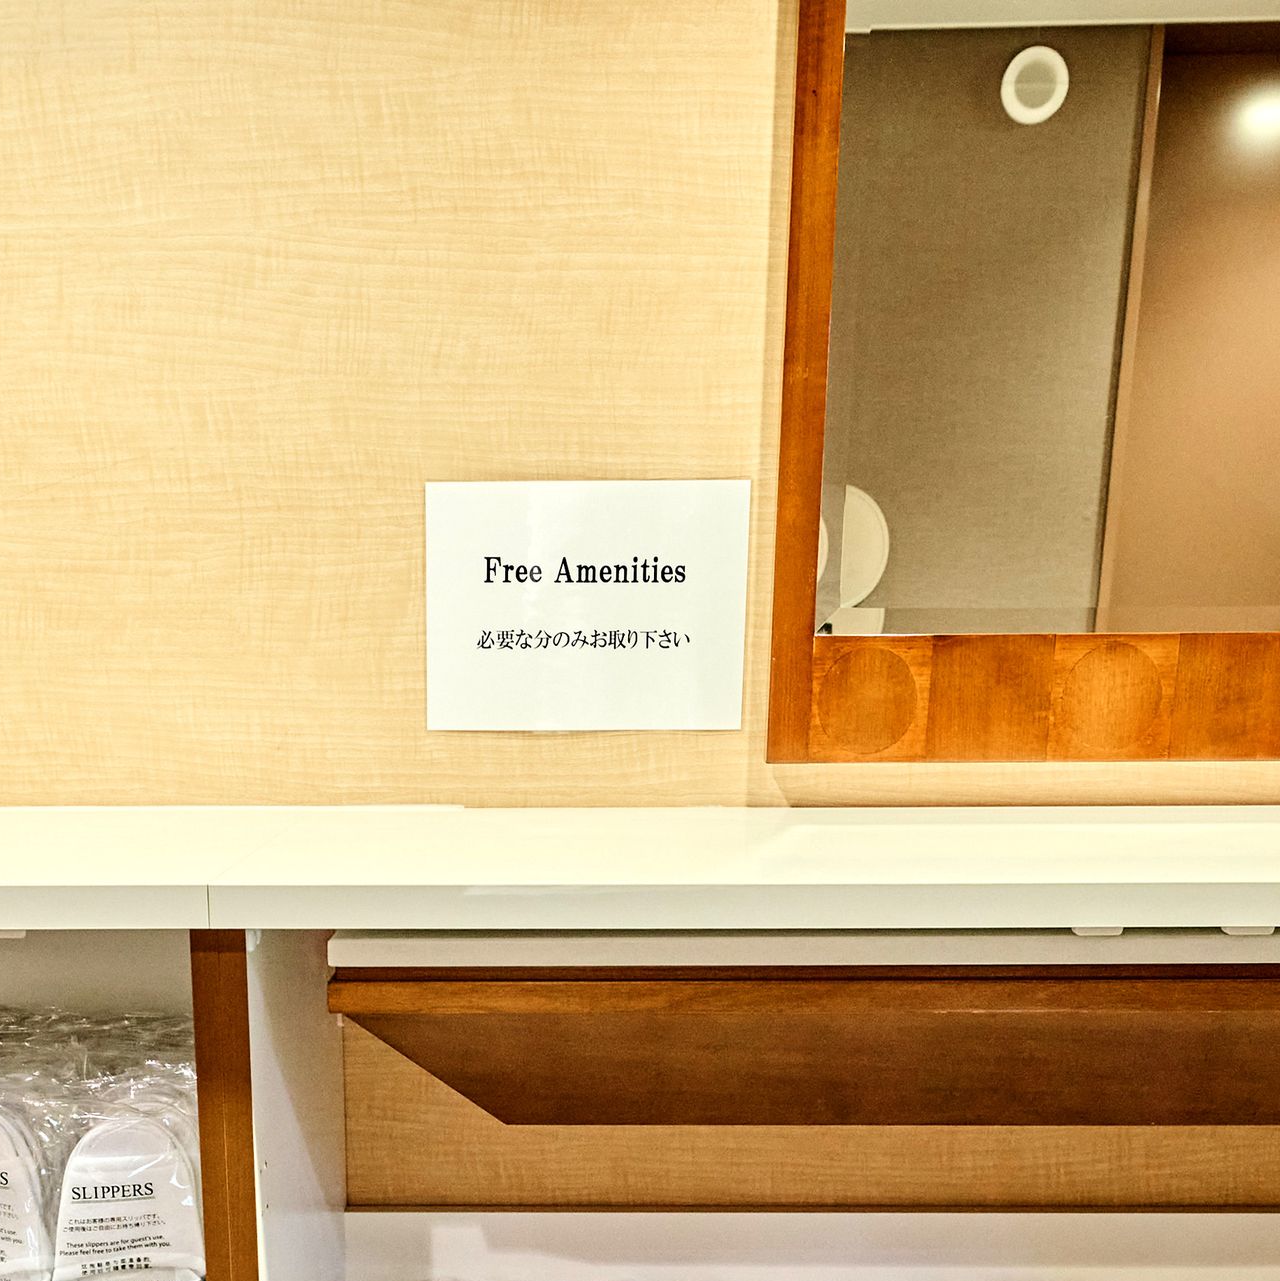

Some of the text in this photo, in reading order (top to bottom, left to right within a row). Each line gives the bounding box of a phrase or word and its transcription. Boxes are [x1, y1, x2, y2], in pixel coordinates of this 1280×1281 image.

[484, 556, 686, 583] Free Amenities
[476, 629, 690, 650] 必要な分のみお取り下さい
[71, 1182, 154, 1200] SLIPPERS
